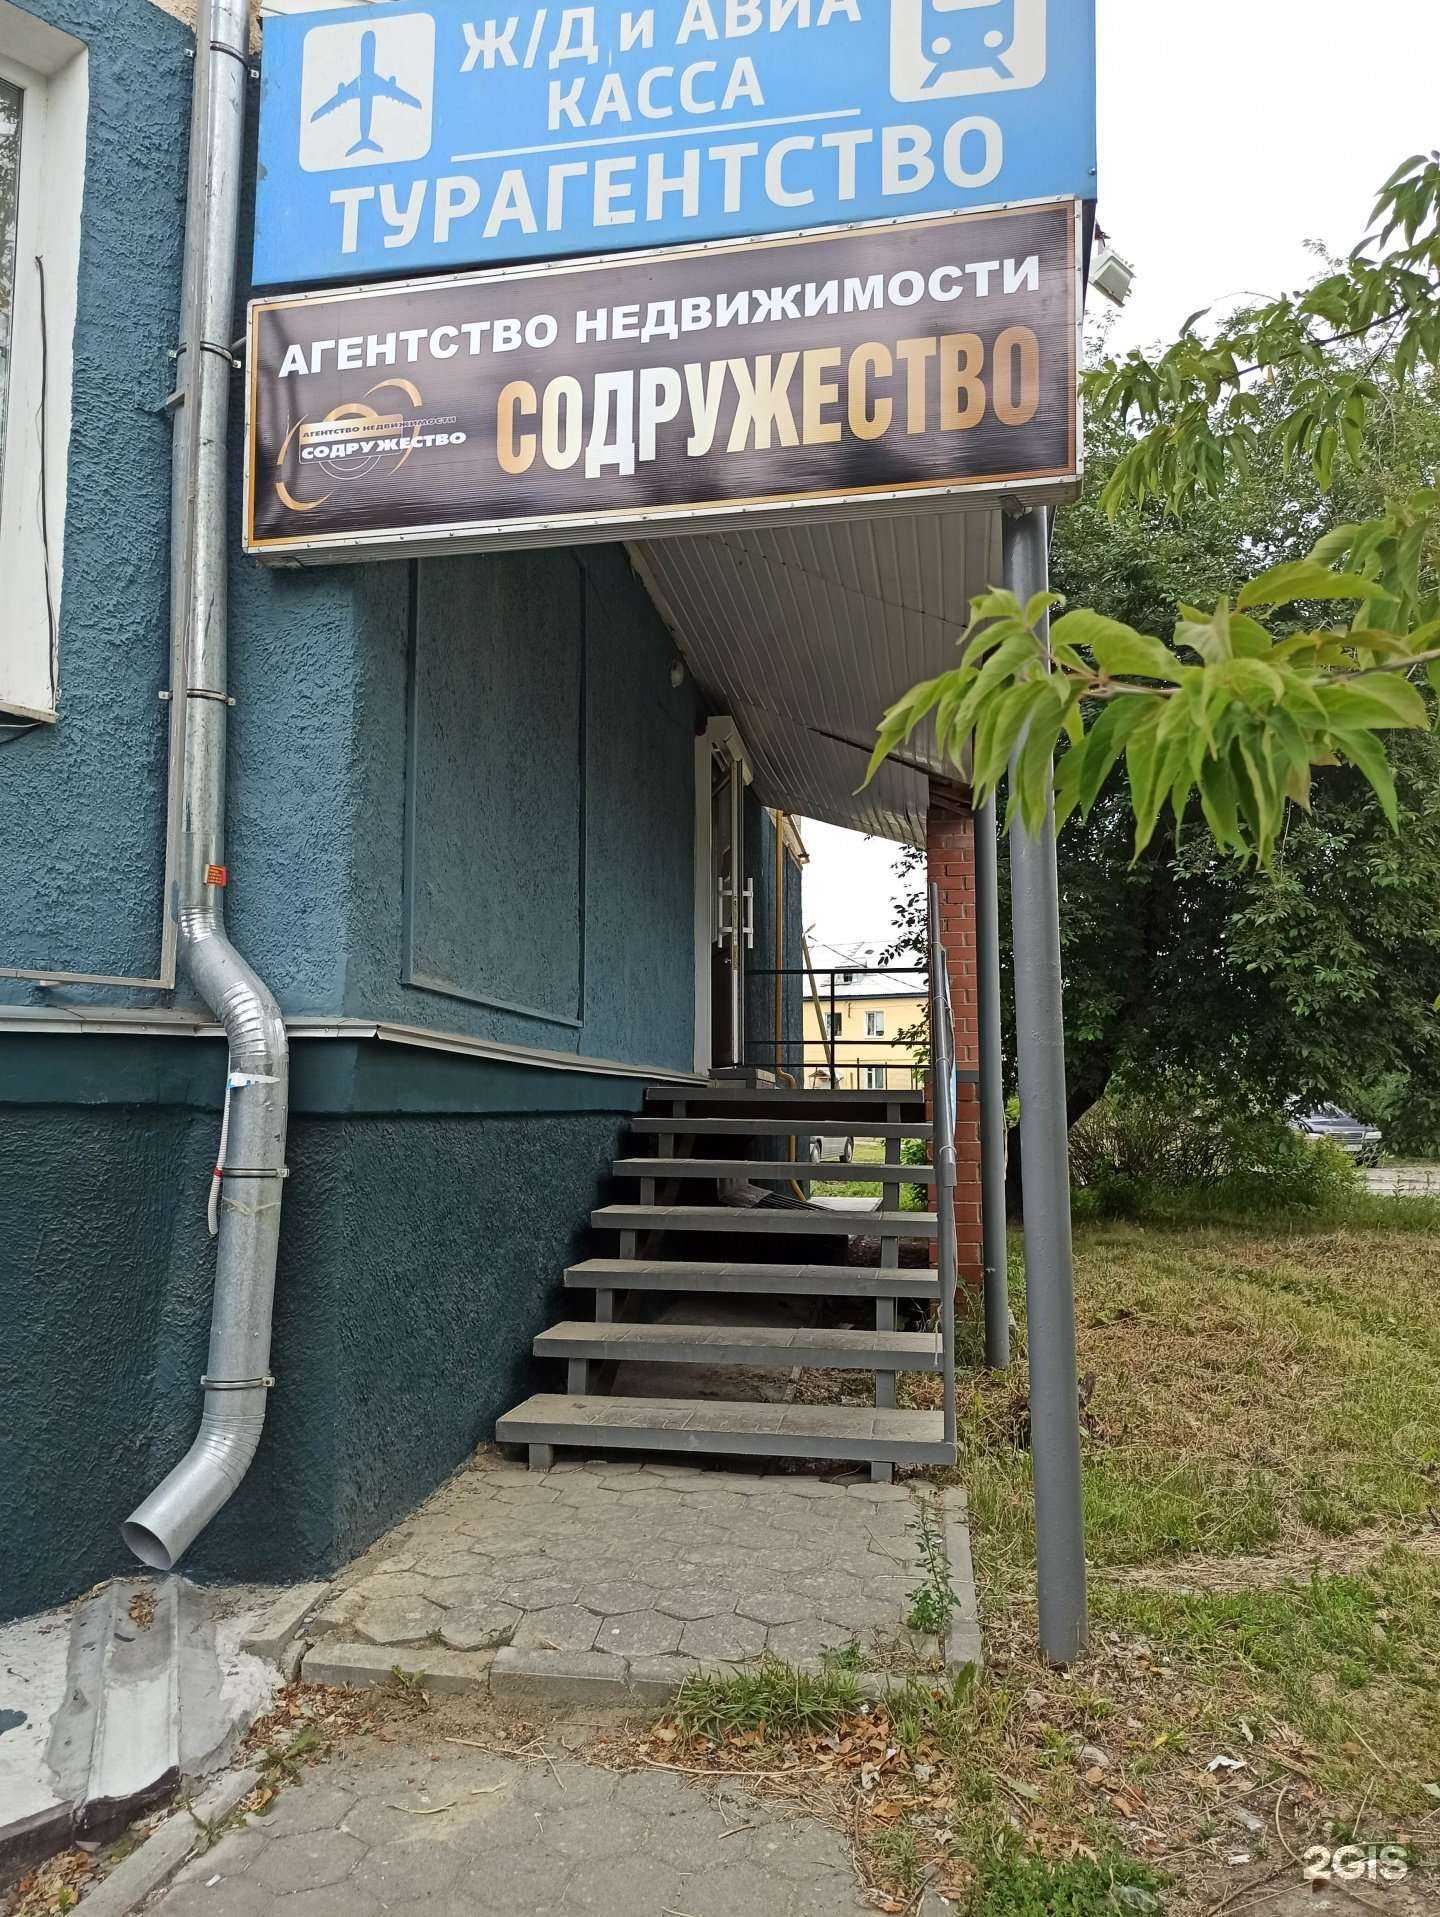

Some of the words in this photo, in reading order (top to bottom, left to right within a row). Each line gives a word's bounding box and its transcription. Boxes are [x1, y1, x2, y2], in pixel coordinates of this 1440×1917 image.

[461, 6, 600, 72] Ж/Д
[620, 9, 654, 52] и
[548, 57, 765, 130] КАССА
[330, 115, 1003, 253] ТУРАГЕНТСТВО
[278, 314, 558, 378] АГЕНТСТВО
[575, 255, 1042, 343] НЕДВИЖИМОСТИ
[302, 426, 360, 438] АГЕНТСТВО
[362, 416, 457, 432] НЕДВИЖИМОСТИ
[497, 325, 1040, 479] СОДРУЖЕСТВО
[301, 432, 467, 459] СОДРУЖЕСТВО
